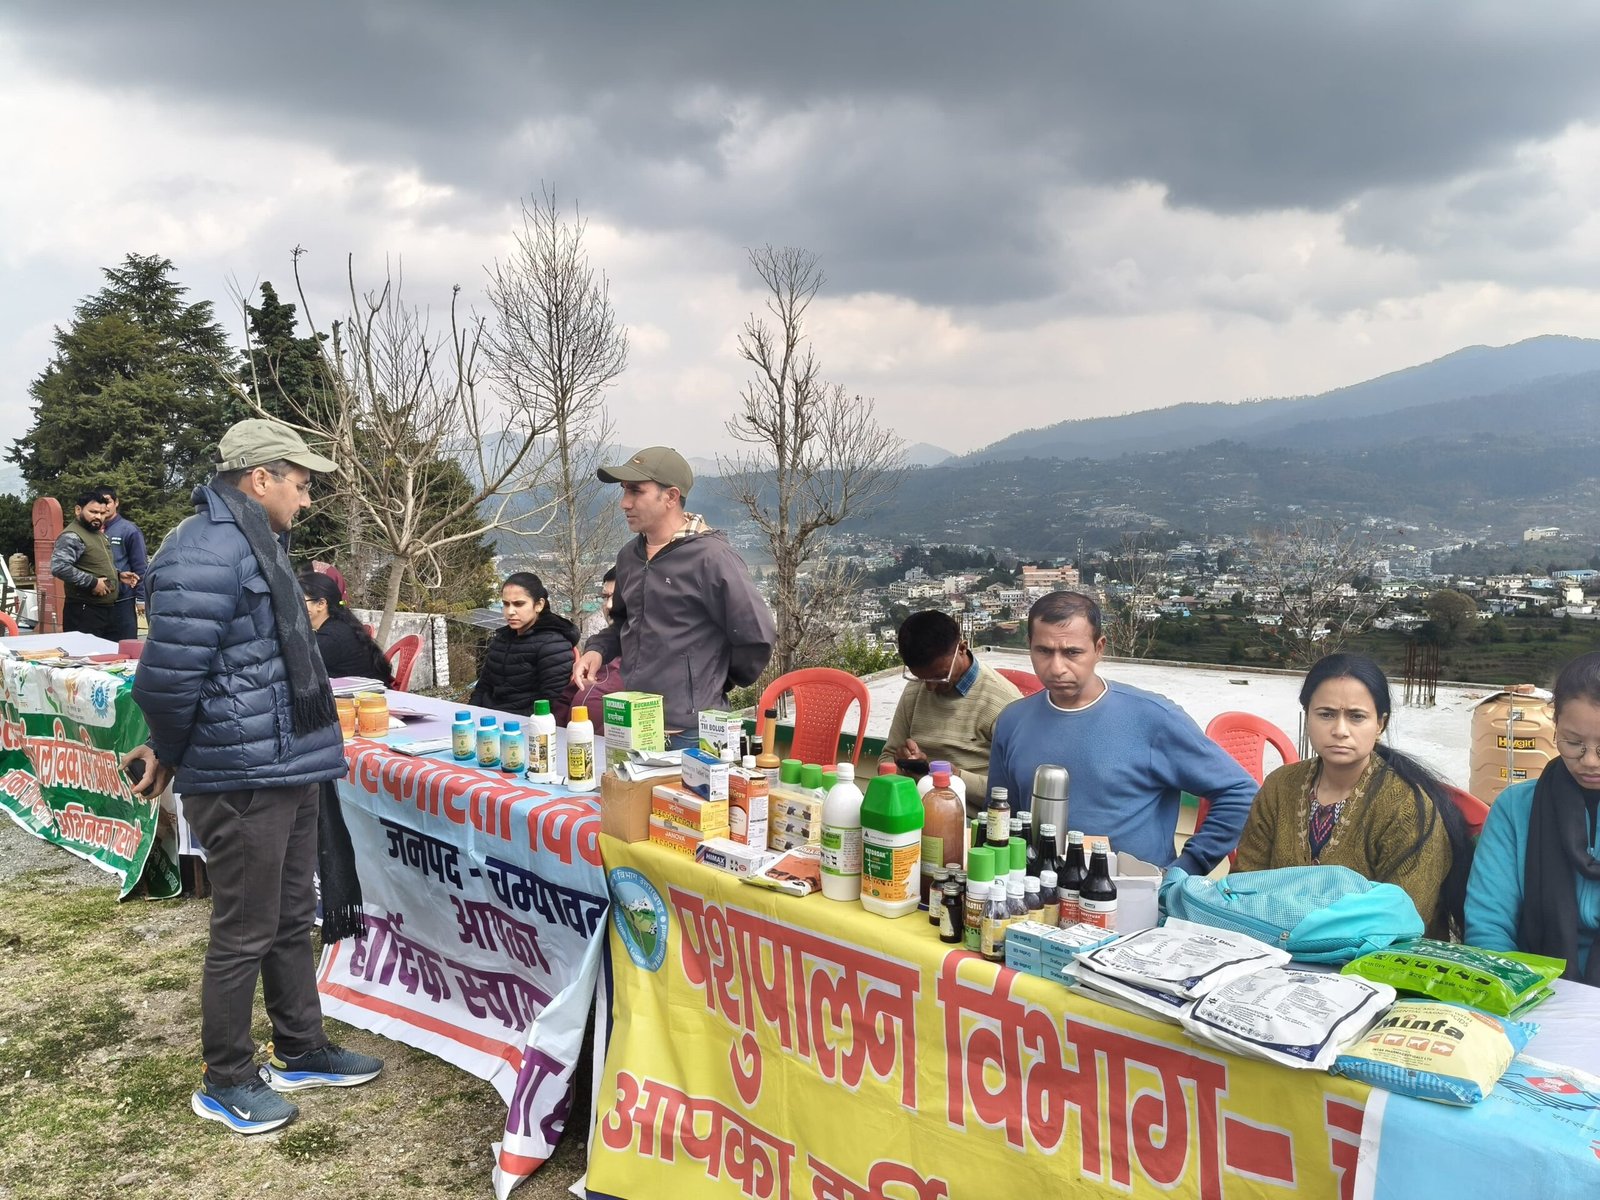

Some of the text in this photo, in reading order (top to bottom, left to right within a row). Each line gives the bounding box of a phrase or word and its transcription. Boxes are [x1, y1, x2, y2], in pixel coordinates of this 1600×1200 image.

[709, 724, 725, 732] BOLUS
[665, 831, 686, 842] JANOVA
[379, 818, 463, 890] जनपद
[705, 852, 725, 864] HIMAX
[617, 869, 638, 881] विभाग
[450, 895, 552, 975] आपका
[669, 889, 922, 1110] पशुपालन
[1376, 1015, 1465, 1041] Minfa
[602, 1072, 796, 1200] आपका
